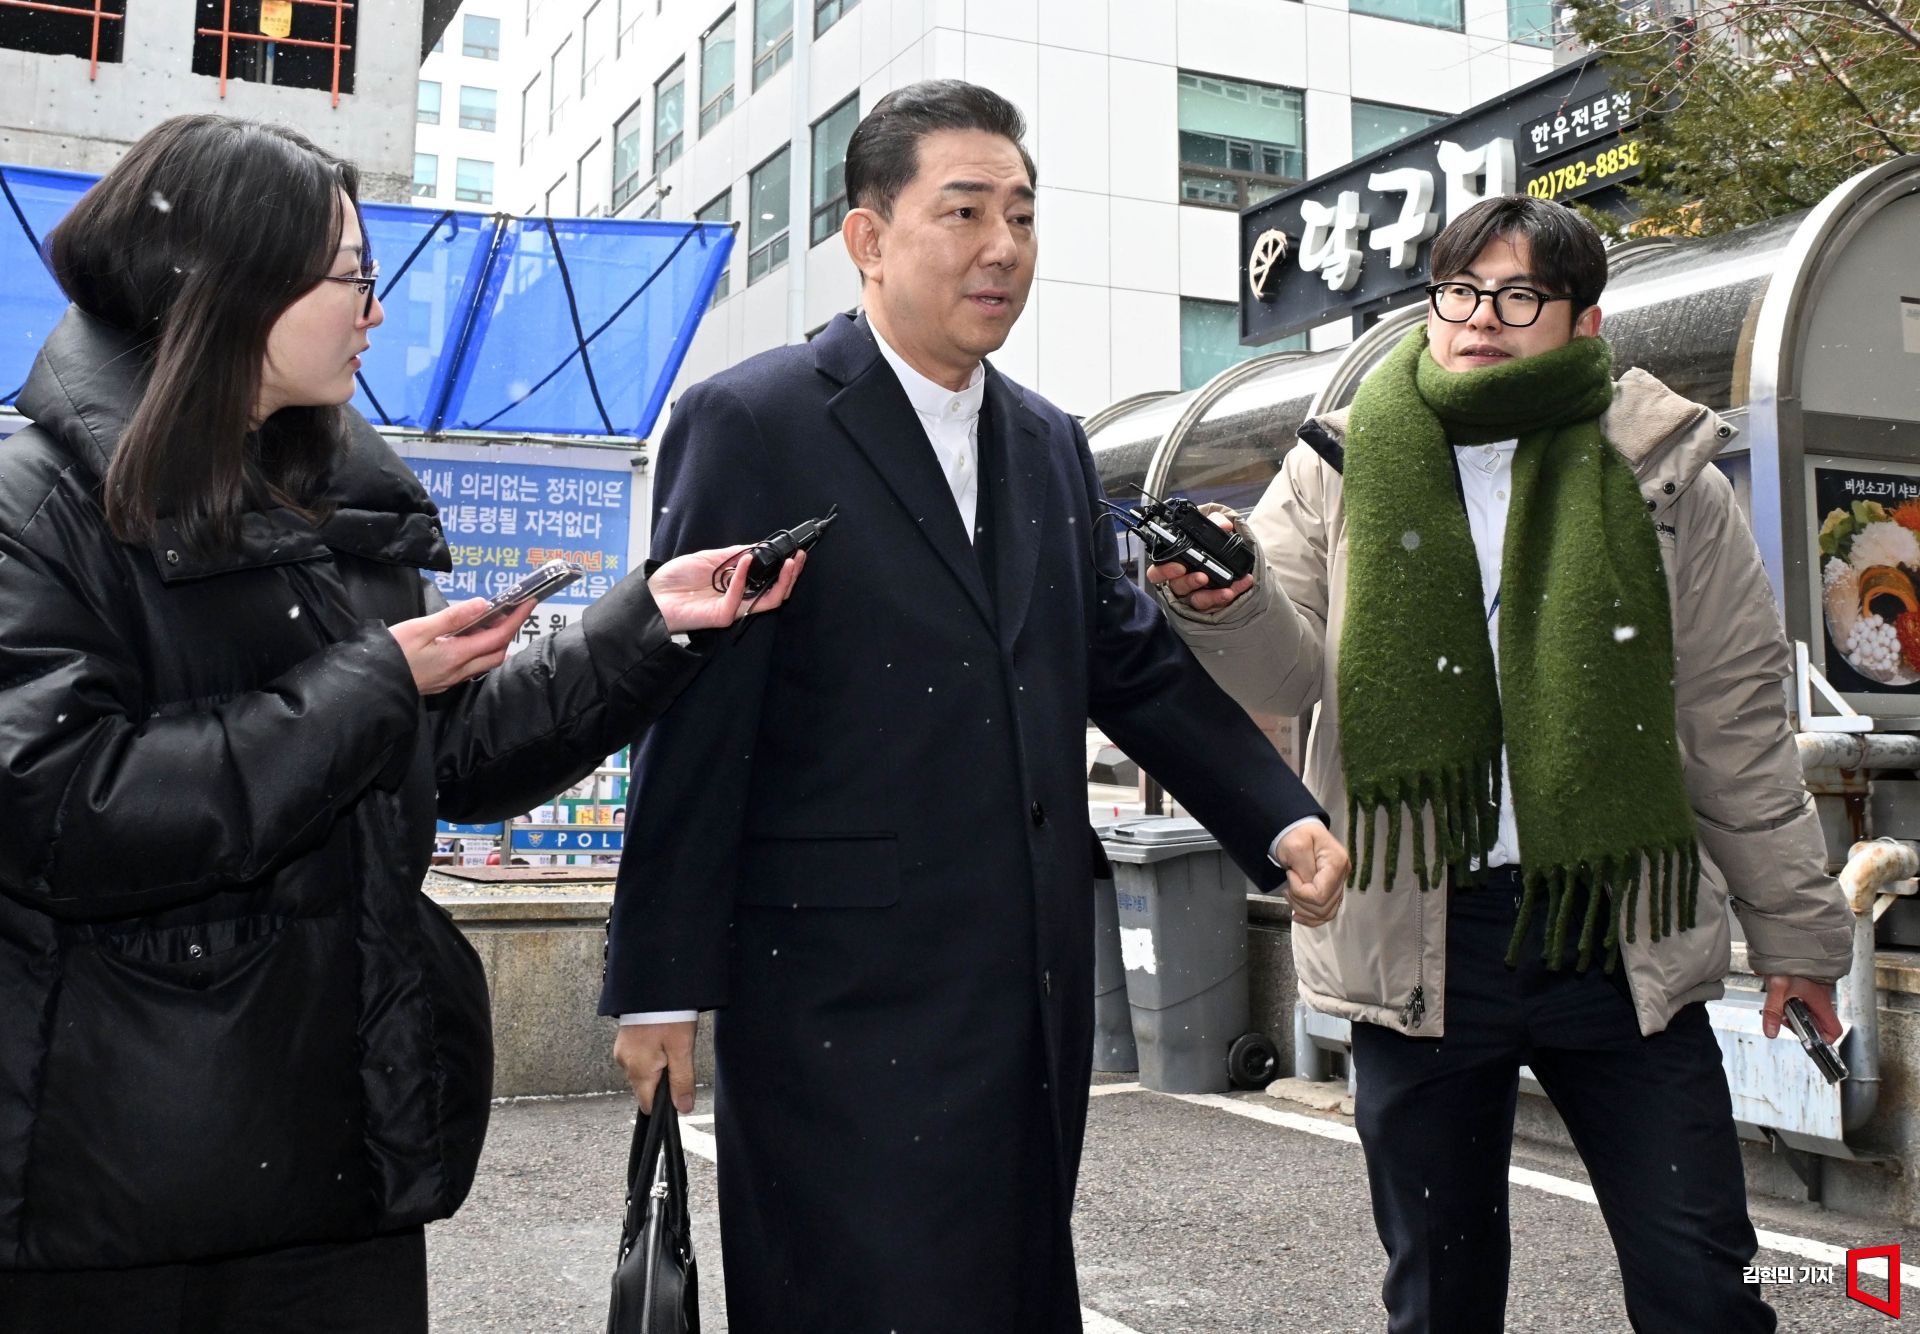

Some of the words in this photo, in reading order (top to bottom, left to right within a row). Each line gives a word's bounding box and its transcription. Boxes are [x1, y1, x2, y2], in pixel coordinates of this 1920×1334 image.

[460, 472, 539, 503] 의리없는
[546, 477, 623, 508] 정치인은
[1844, 478, 1896, 498] 버섯소고기
[1898, 482, 1920, 499] 샤브
[439, 504, 518, 535] 대통령될
[524, 508, 602, 539] 자격없다
[434, 569, 477, 594] 현재
